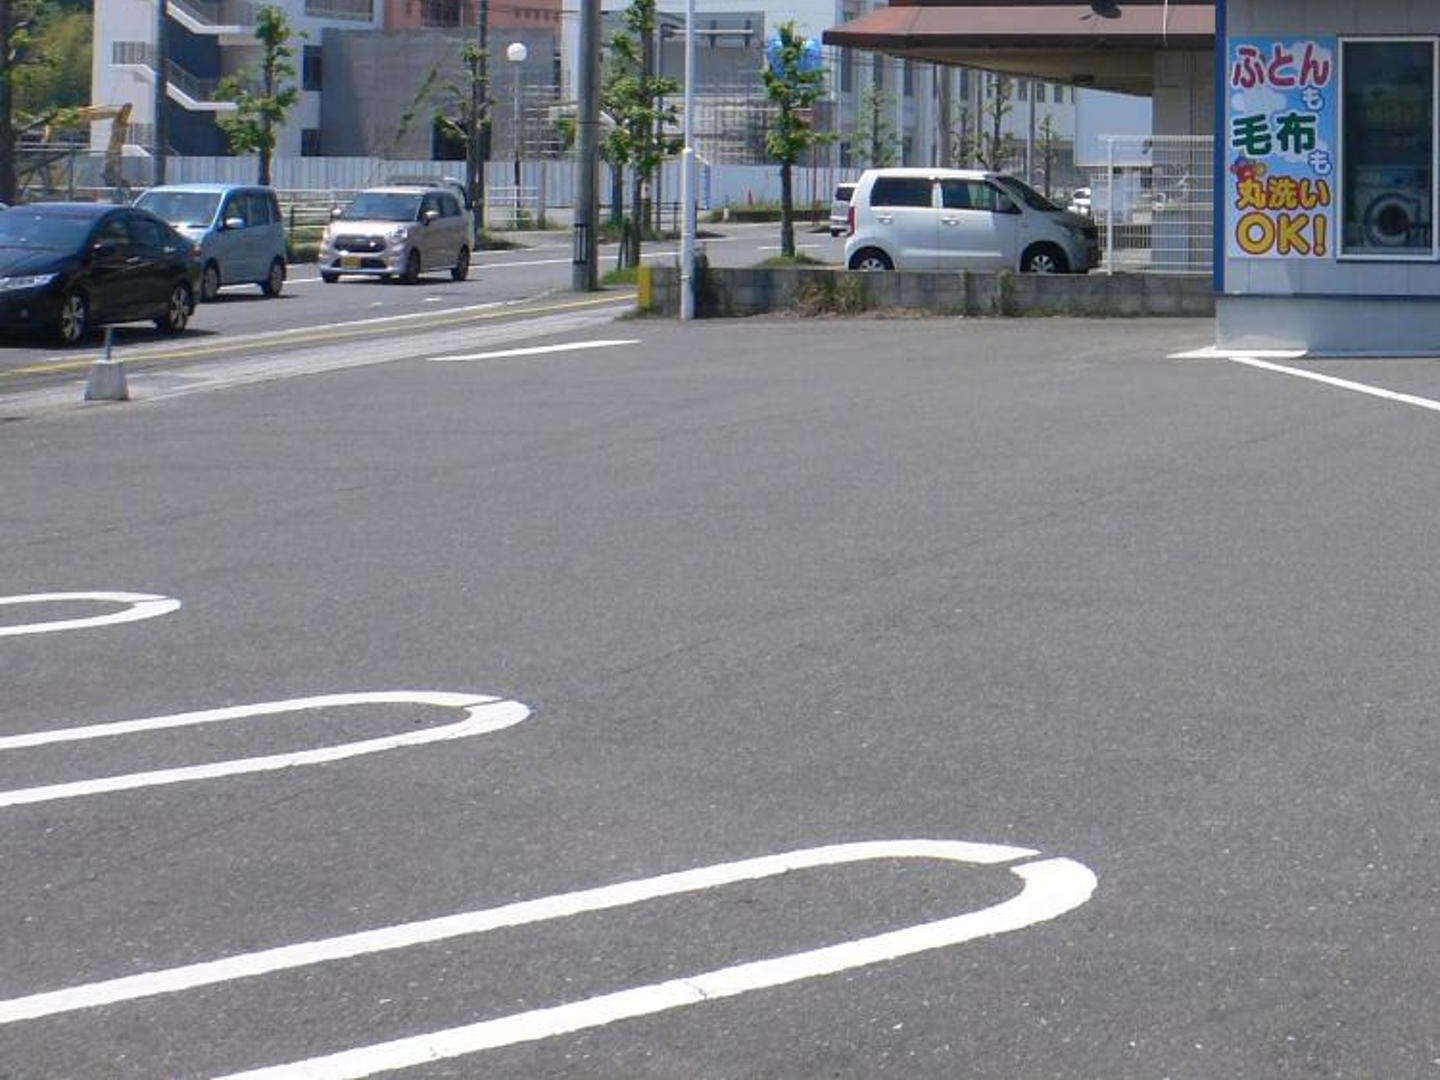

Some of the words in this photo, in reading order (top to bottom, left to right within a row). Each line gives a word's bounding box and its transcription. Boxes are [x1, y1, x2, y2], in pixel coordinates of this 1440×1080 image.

[1231, 42, 1331, 89] ふとん
[1232, 112, 1318, 156] 毛布
[1236, 176, 1331, 211] 丸洗い
[1235, 211, 1327, 257] OK!
